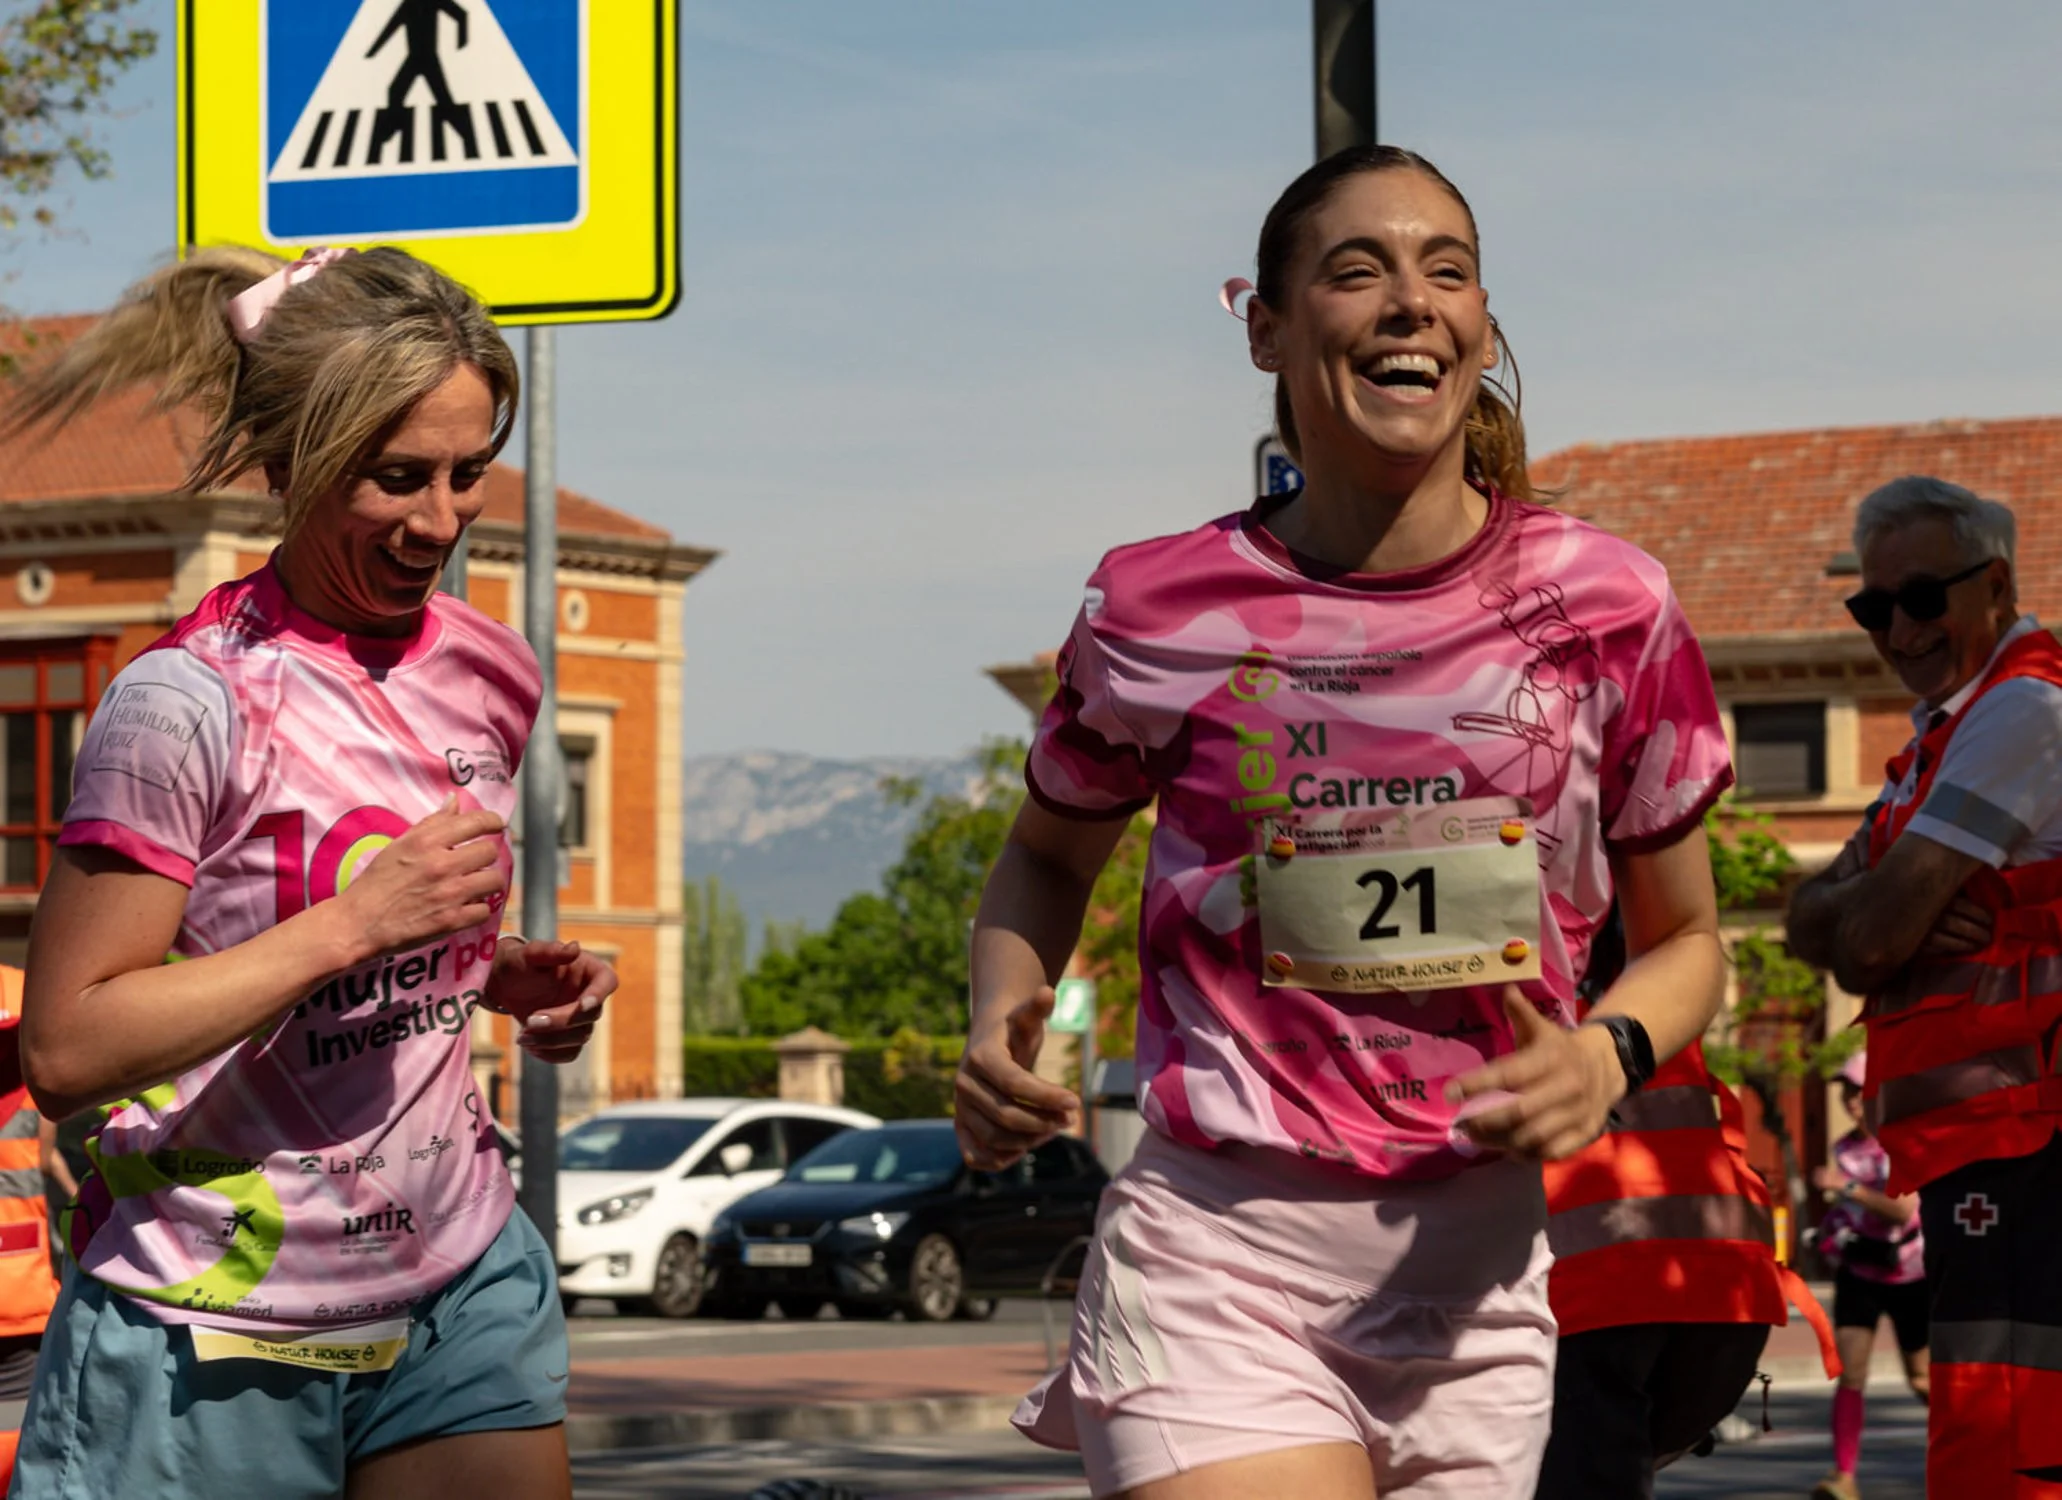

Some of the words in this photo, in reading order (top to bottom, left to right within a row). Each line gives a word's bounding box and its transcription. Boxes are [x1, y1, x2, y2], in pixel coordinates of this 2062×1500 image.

[1288, 665, 1331, 677] contra
[1335, 664, 1347, 676] el
[1309, 681, 1325, 692] La
[1327, 679, 1361, 694] Rioja
[1285, 722, 1328, 758] XI
[1230, 722, 1293, 813] jer
[1288, 773, 1457, 809] Carrera
[1356, 866, 1437, 941] 21
[1352, 965, 1409, 982] NATUR
[1411, 960, 1465, 977] HOUSE
[1374, 1030, 1413, 1050] Rioja
[184, 1156, 266, 1179] Logroño
[329, 1156, 351, 1175] La
[269, 1345, 312, 1359] NATUR
[315, 1346, 361, 1361] HOUSE
